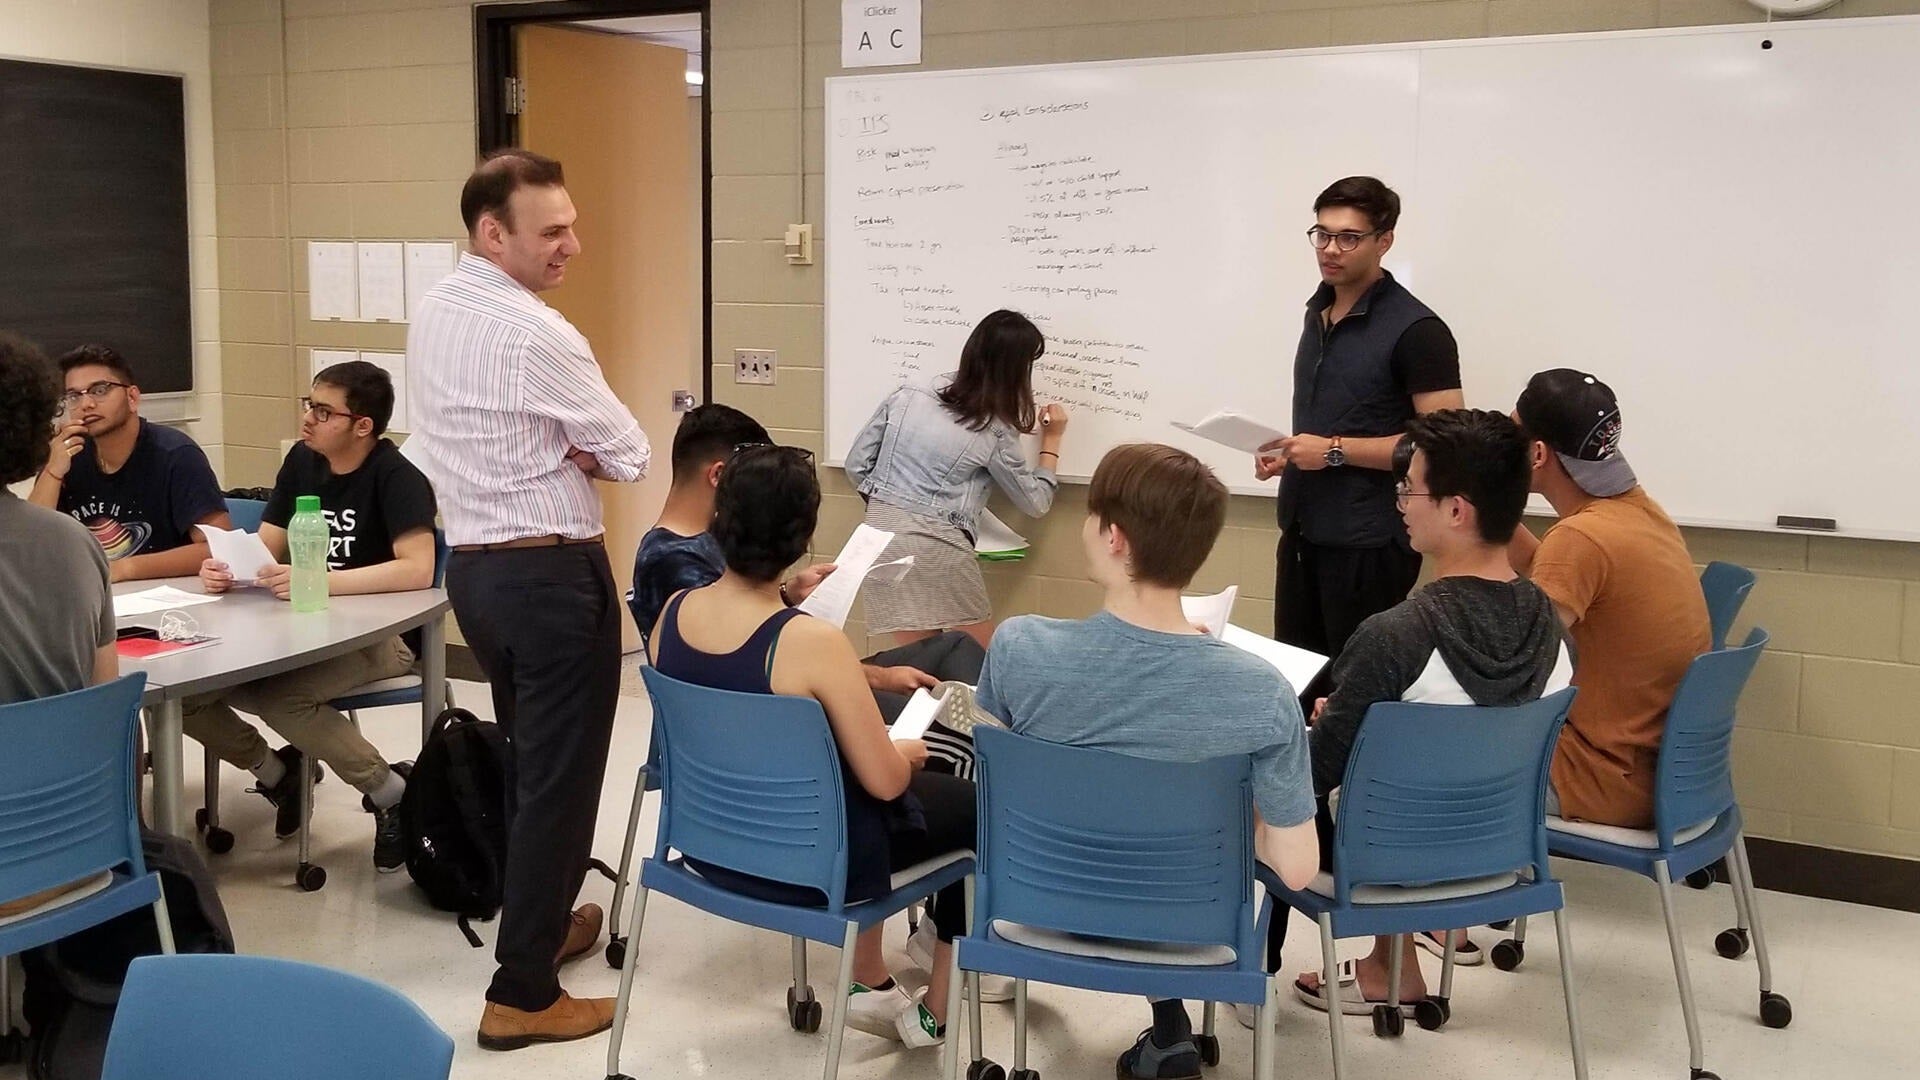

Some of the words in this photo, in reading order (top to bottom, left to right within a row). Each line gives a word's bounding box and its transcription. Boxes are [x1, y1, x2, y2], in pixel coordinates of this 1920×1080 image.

[858, 31, 873, 51] A
[890, 29, 904, 48] C
[71, 502, 105, 521] PACE
[110, 503, 121, 517] IS
[326, 536, 356, 558] RT
